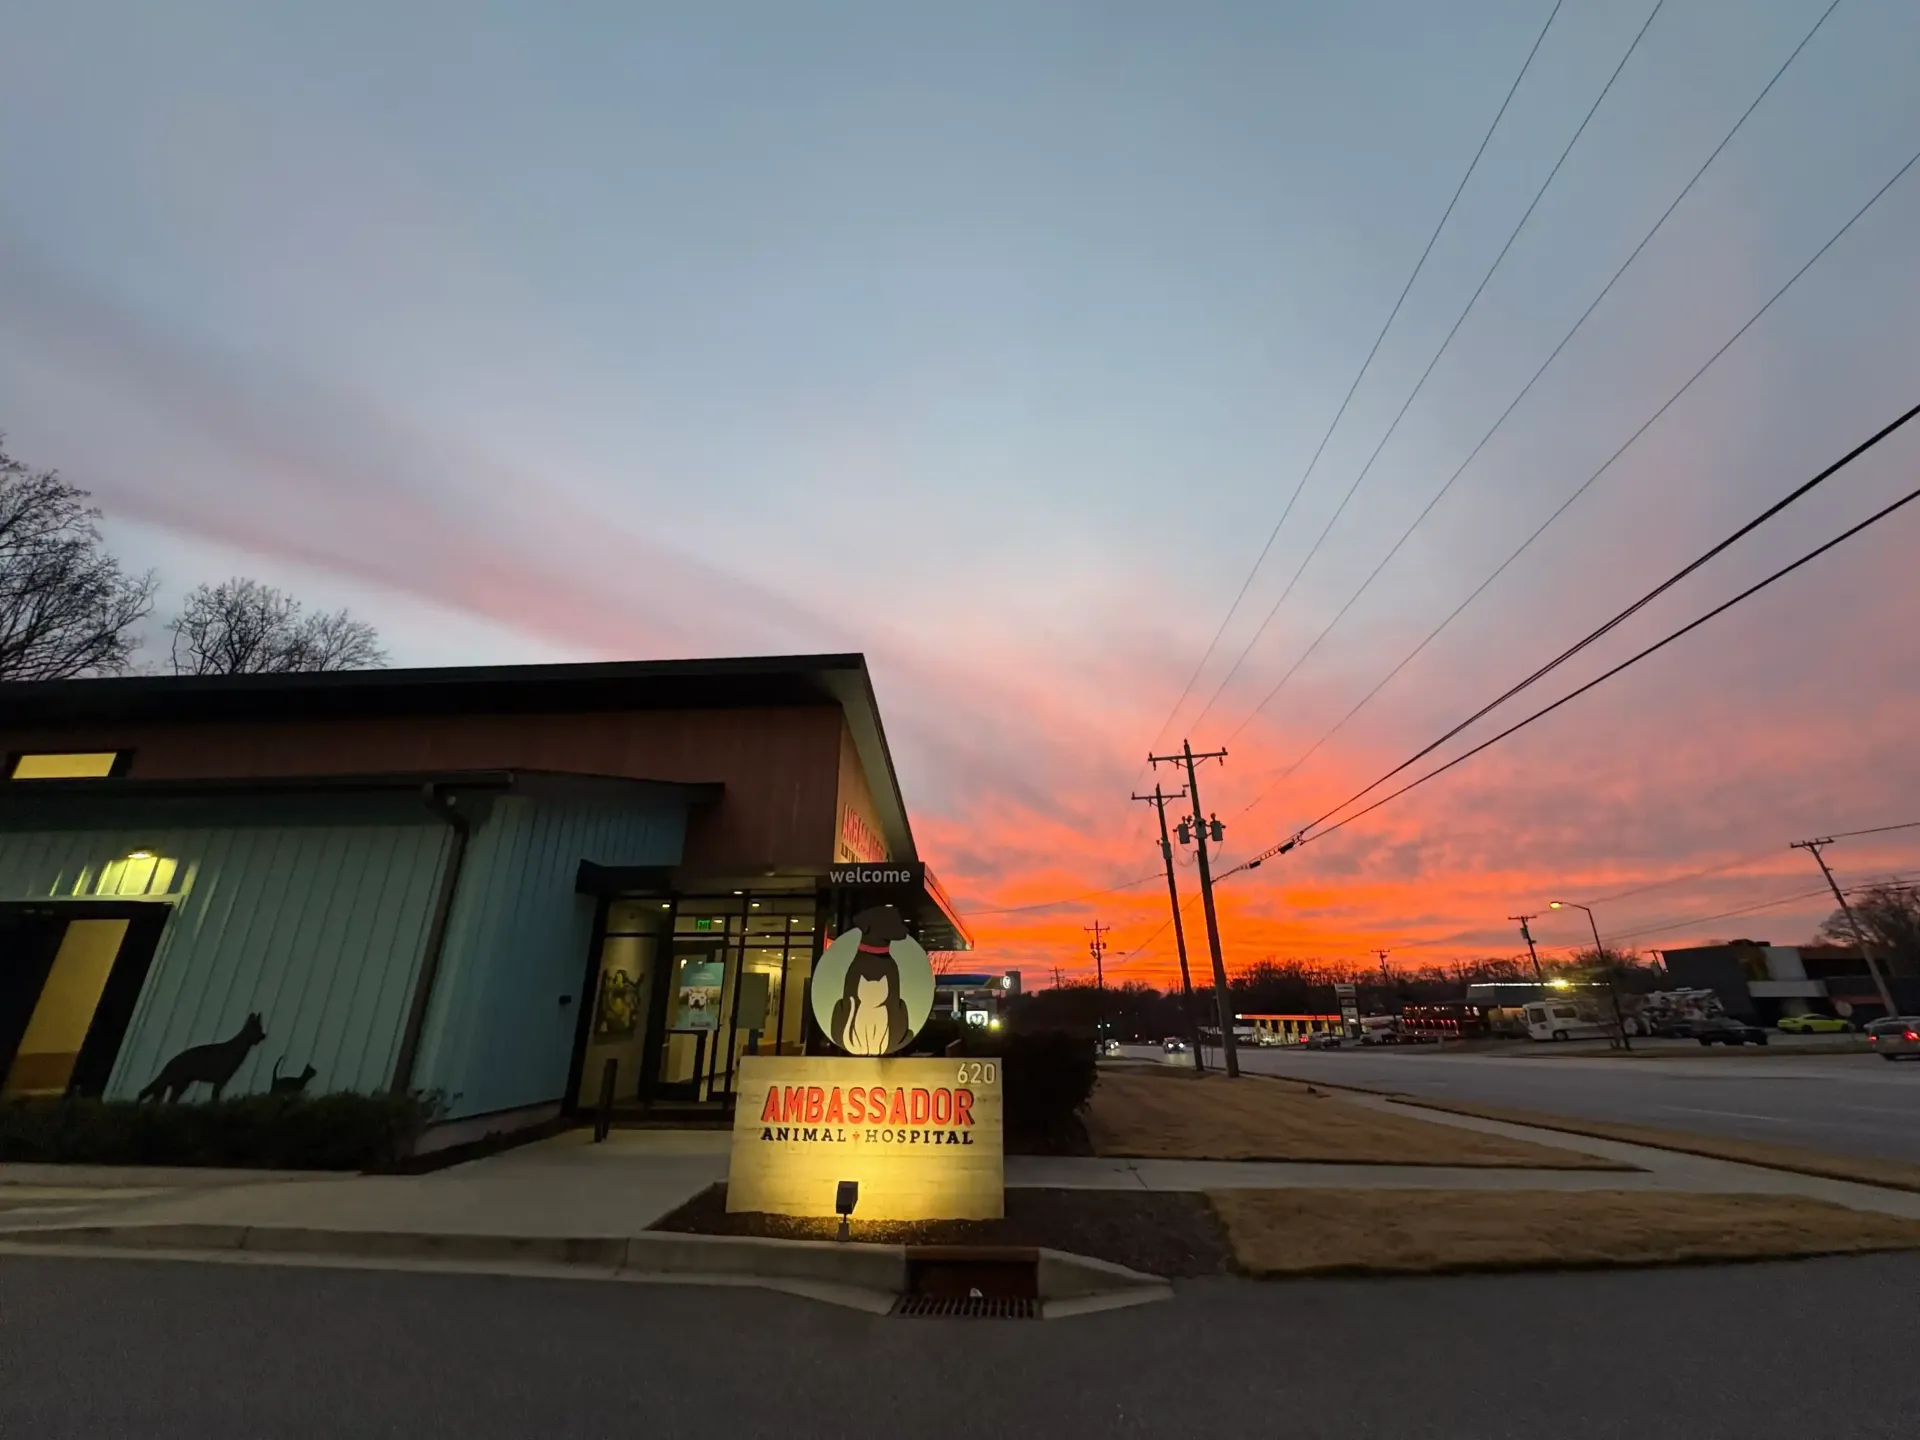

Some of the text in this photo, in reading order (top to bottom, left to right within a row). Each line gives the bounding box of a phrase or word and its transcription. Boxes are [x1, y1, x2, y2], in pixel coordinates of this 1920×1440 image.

[829, 866, 911, 883] welcome
[957, 1063, 996, 1085] 620
[761, 1086, 976, 1126] AMBASSADOR
[760, 1127, 974, 1145] ANIMAL HOSPITAL
